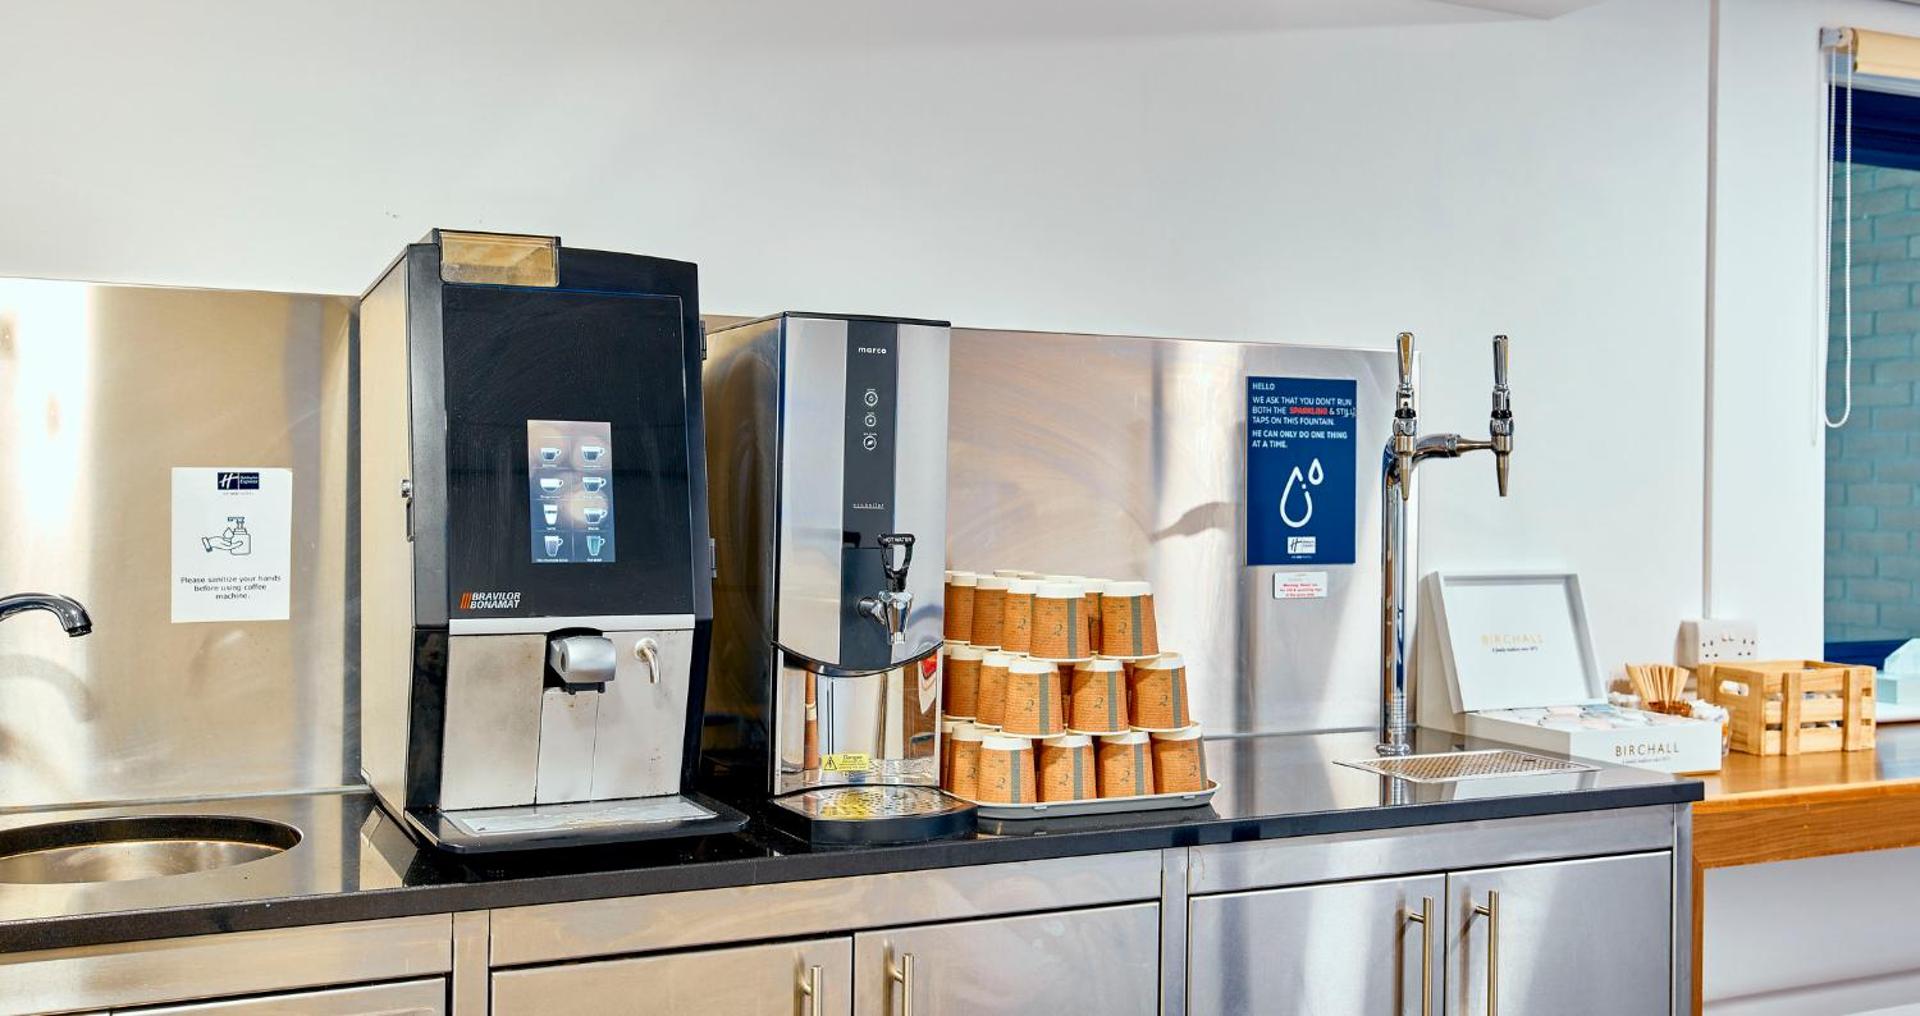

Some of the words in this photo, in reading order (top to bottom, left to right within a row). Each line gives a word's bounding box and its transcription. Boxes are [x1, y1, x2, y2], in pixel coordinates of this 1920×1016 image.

[1252, 382, 1276, 391] HELLO
[1252, 396, 1264, 404] WE
[1265, 396, 1280, 405] ASK
[1281, 396, 1298, 405] THAT
[1300, 397, 1314, 405] YOU
[1315, 397, 1335, 406] DON'T
[1337, 398, 1353, 406] RUN
[1252, 406, 1272, 414] BOTH
[1273, 407, 1287, 415] THE
[1329, 408, 1335, 416] &
[1252, 417, 1270, 425] TAPS
[1270, 417, 1282, 425] ON
[1283, 417, 1299, 425] THIS
[1252, 430, 1262, 438] HE
[1263, 430, 1278, 438] CAN
[1280, 430, 1298, 439] ONLY
[1299, 431, 1310, 439] DO
[1310, 431, 1325, 439] ONE
[1326, 431, 1348, 439] THING
[1252, 440, 1261, 448] AT
[180, 576, 205, 584] Please
[194, 584, 219, 592] before
[221, 584, 241, 592] using
[244, 583, 267, 591] coffee
[472, 591, 521, 600] BRAVILOR
[470, 600, 520, 609] BONAMAT
[1615, 741, 1680, 757] BIRCHALL
